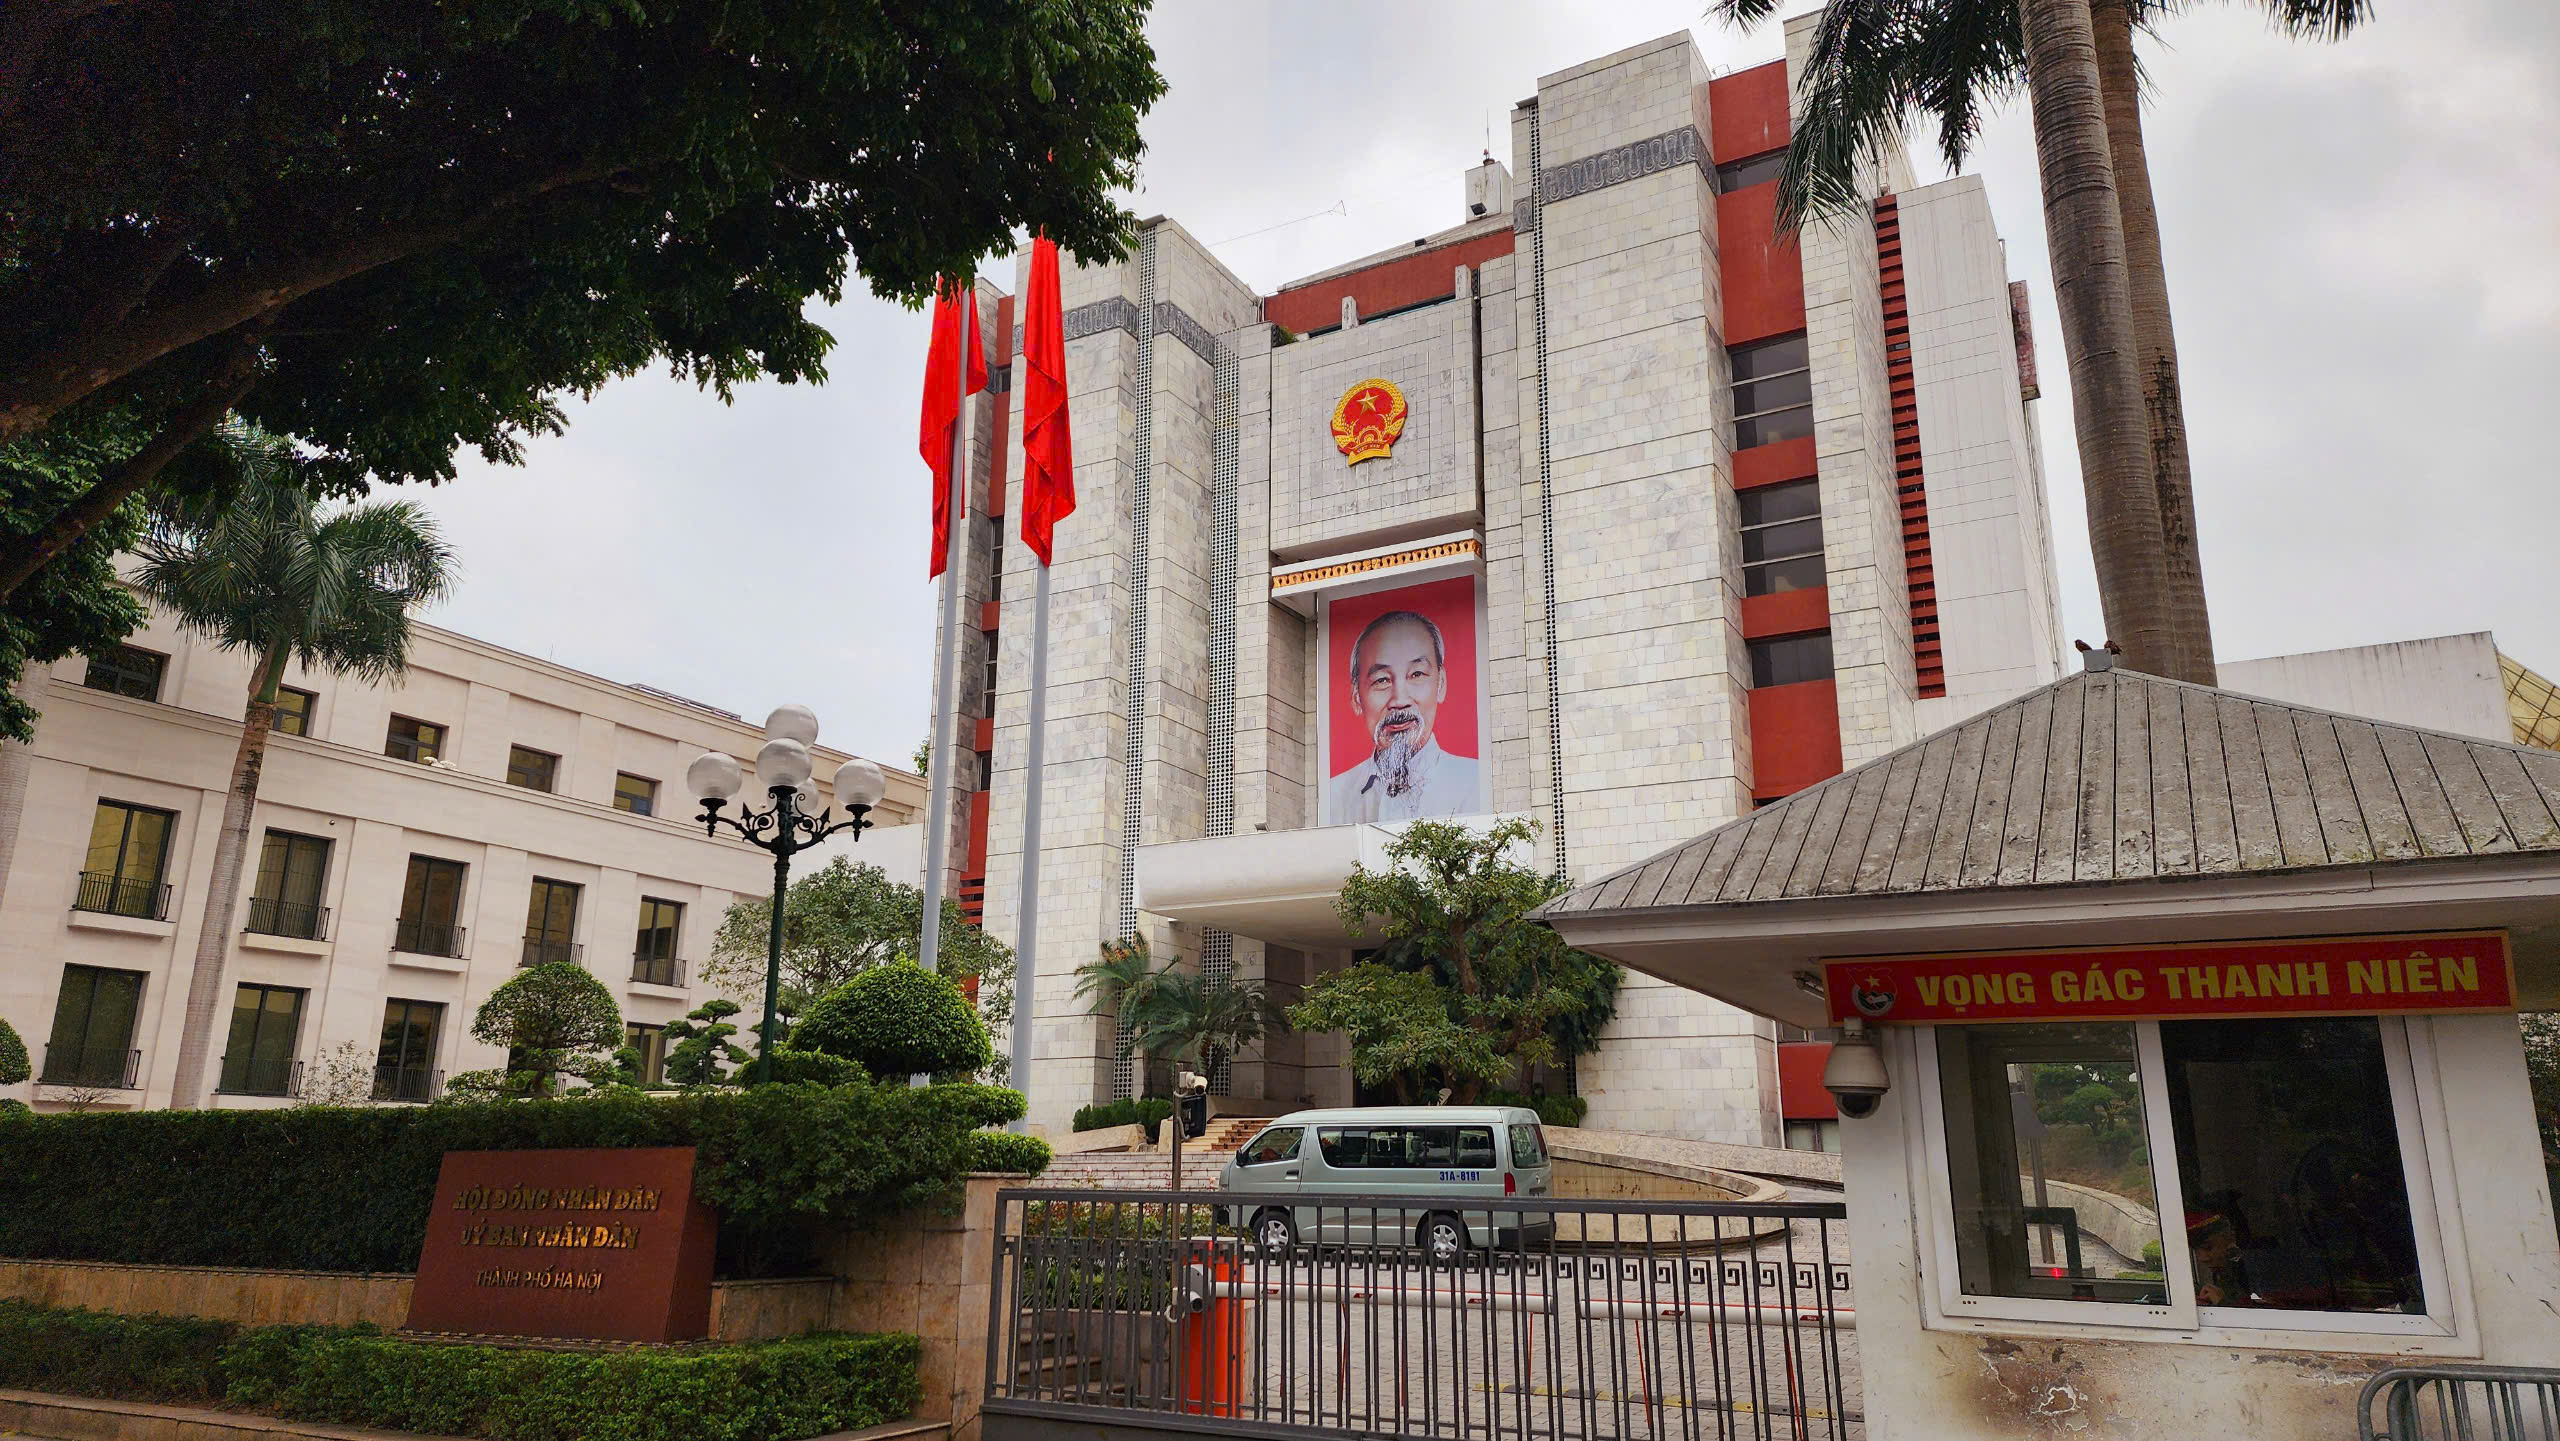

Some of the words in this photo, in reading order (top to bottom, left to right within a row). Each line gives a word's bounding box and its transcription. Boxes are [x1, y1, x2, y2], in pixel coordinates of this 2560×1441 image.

[1914, 971, 2036, 1013] VỌNG
[2050, 961, 2146, 1003] GÁC
[2158, 961, 2330, 1000] THANH
[2346, 950, 2480, 995] NIÊN
[1439, 1171, 1480, 1181] 31A-8191
[551, 1184, 612, 1212] NHÂN
[614, 1184, 662, 1212] DÂN
[488, 1224, 530, 1248] BAN
[523, 1264, 554, 1289] PHỐ
[576, 1268, 604, 1295] NỘI
